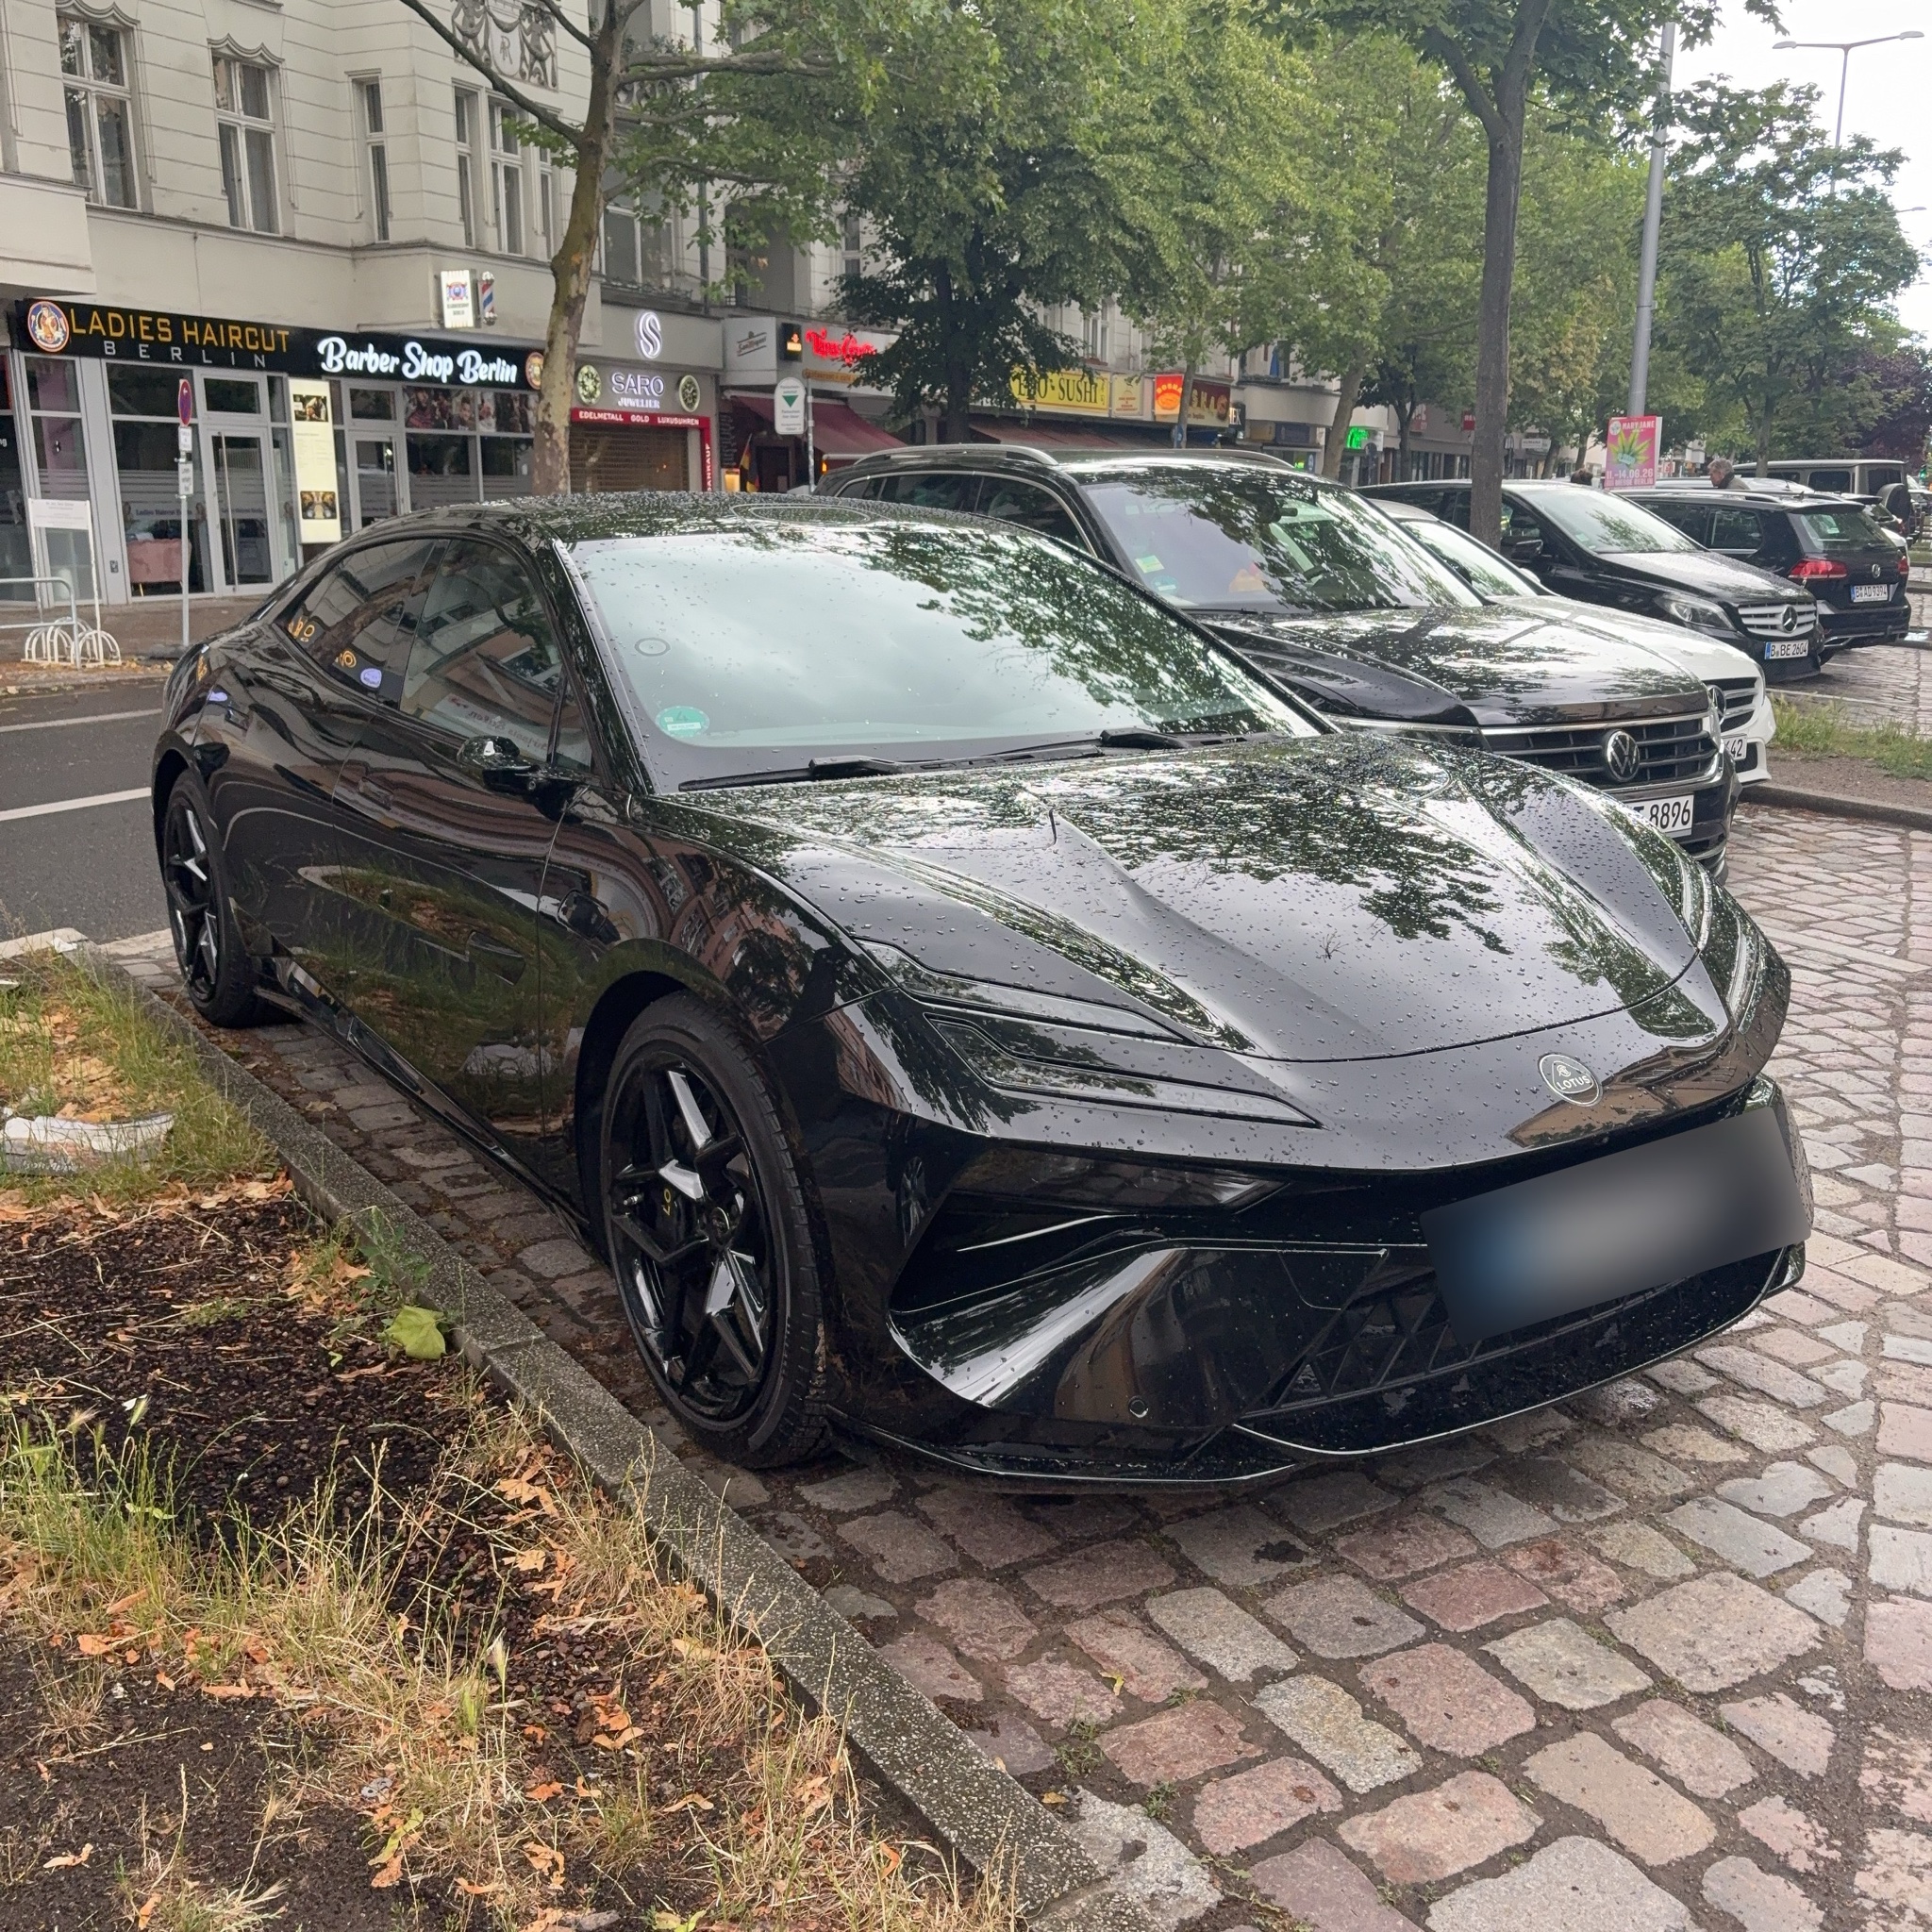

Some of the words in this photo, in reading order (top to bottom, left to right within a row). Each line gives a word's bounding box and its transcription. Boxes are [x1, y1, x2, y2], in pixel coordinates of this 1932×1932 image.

[70, 308, 173, 342] LADIES
[183, 320, 290, 353] HAIRCUT
[104, 341, 266, 368] BERLIN
[317, 336, 400, 374] Barber
[402, 341, 454, 383] Shop
[457, 349, 518, 384] Berlin
[611, 372, 664, 397] SARO
[1018, 374, 1048, 399] EO
[1058, 377, 1098, 404] SUSHI
[618, 397, 660, 409] JUWELIER
[578, 410, 624, 422] EDELMETALL
[630, 414, 650, 423] GOLD
[658, 417, 699, 425] LUXUSUHREN
[1623, 421, 1639, 430] MARY
[1640, 420, 1655, 428] JANE
[1856, 585, 1860, 598] B
[1864, 585, 1872, 597] AD
[1873, 585, 1887, 597] 9394
[1771, 644, 1776, 658] B
[1780, 643, 1790, 657] BE
[1792, 642, 1807, 656] 2604
[1649, 800, 1690, 829] 8896
[1557, 1075, 1591, 1091] LOTUS
